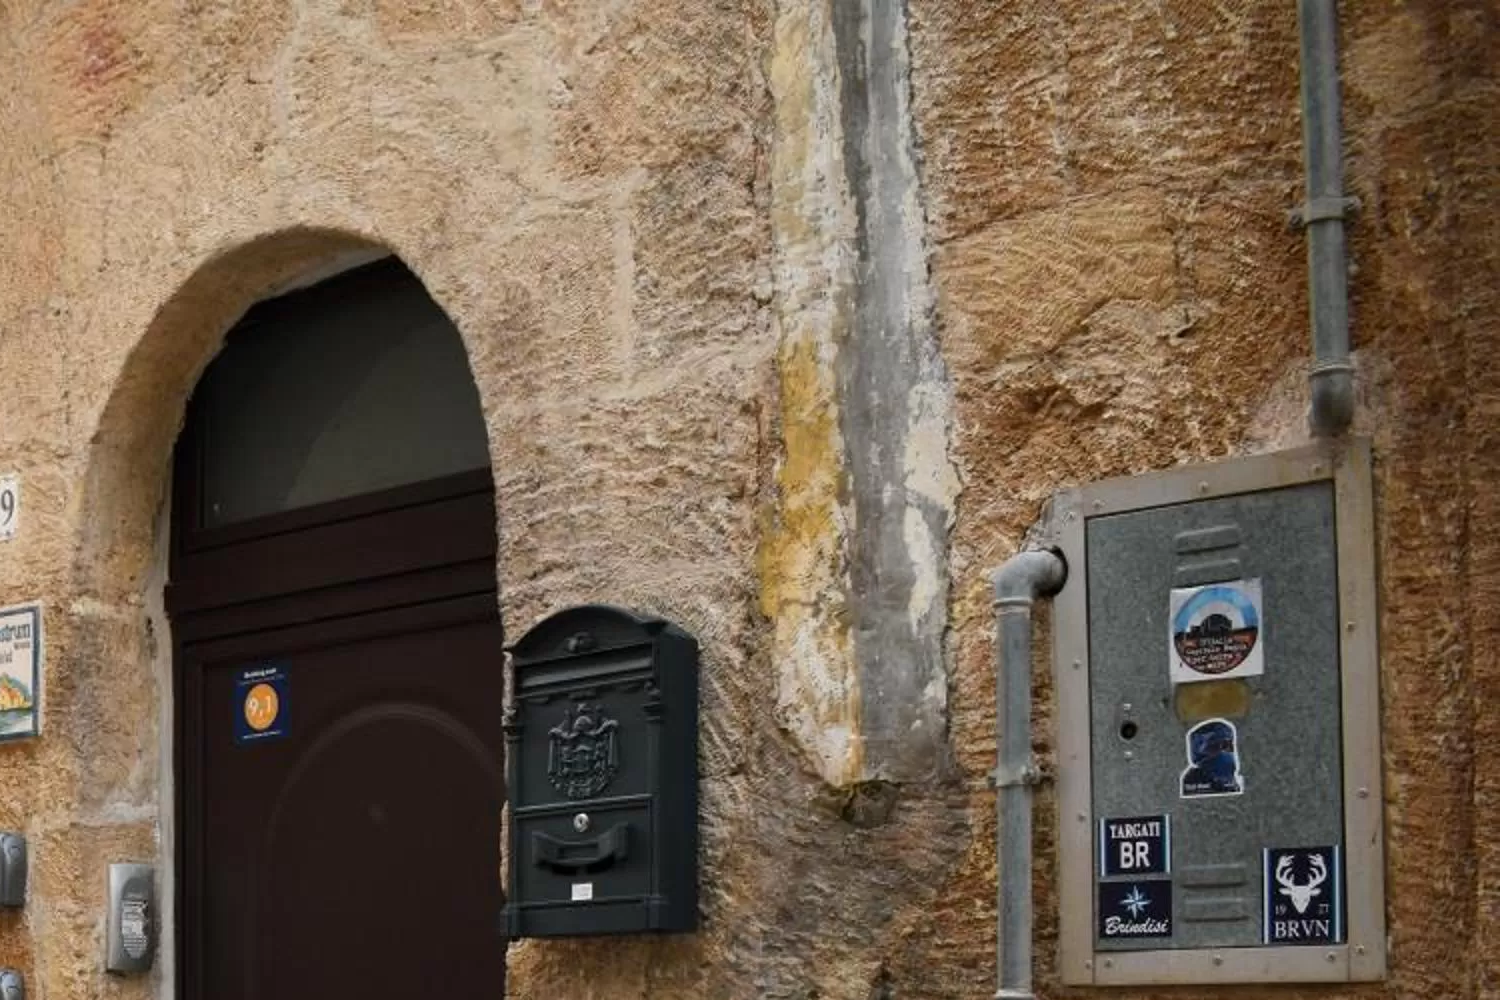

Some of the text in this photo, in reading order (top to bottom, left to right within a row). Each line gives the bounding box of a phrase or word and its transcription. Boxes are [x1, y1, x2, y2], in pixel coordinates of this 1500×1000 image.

[1120, 840, 1151, 869] BR
[1104, 915, 1170, 935] Brindisi
[1274, 919, 1330, 939] BRVN
